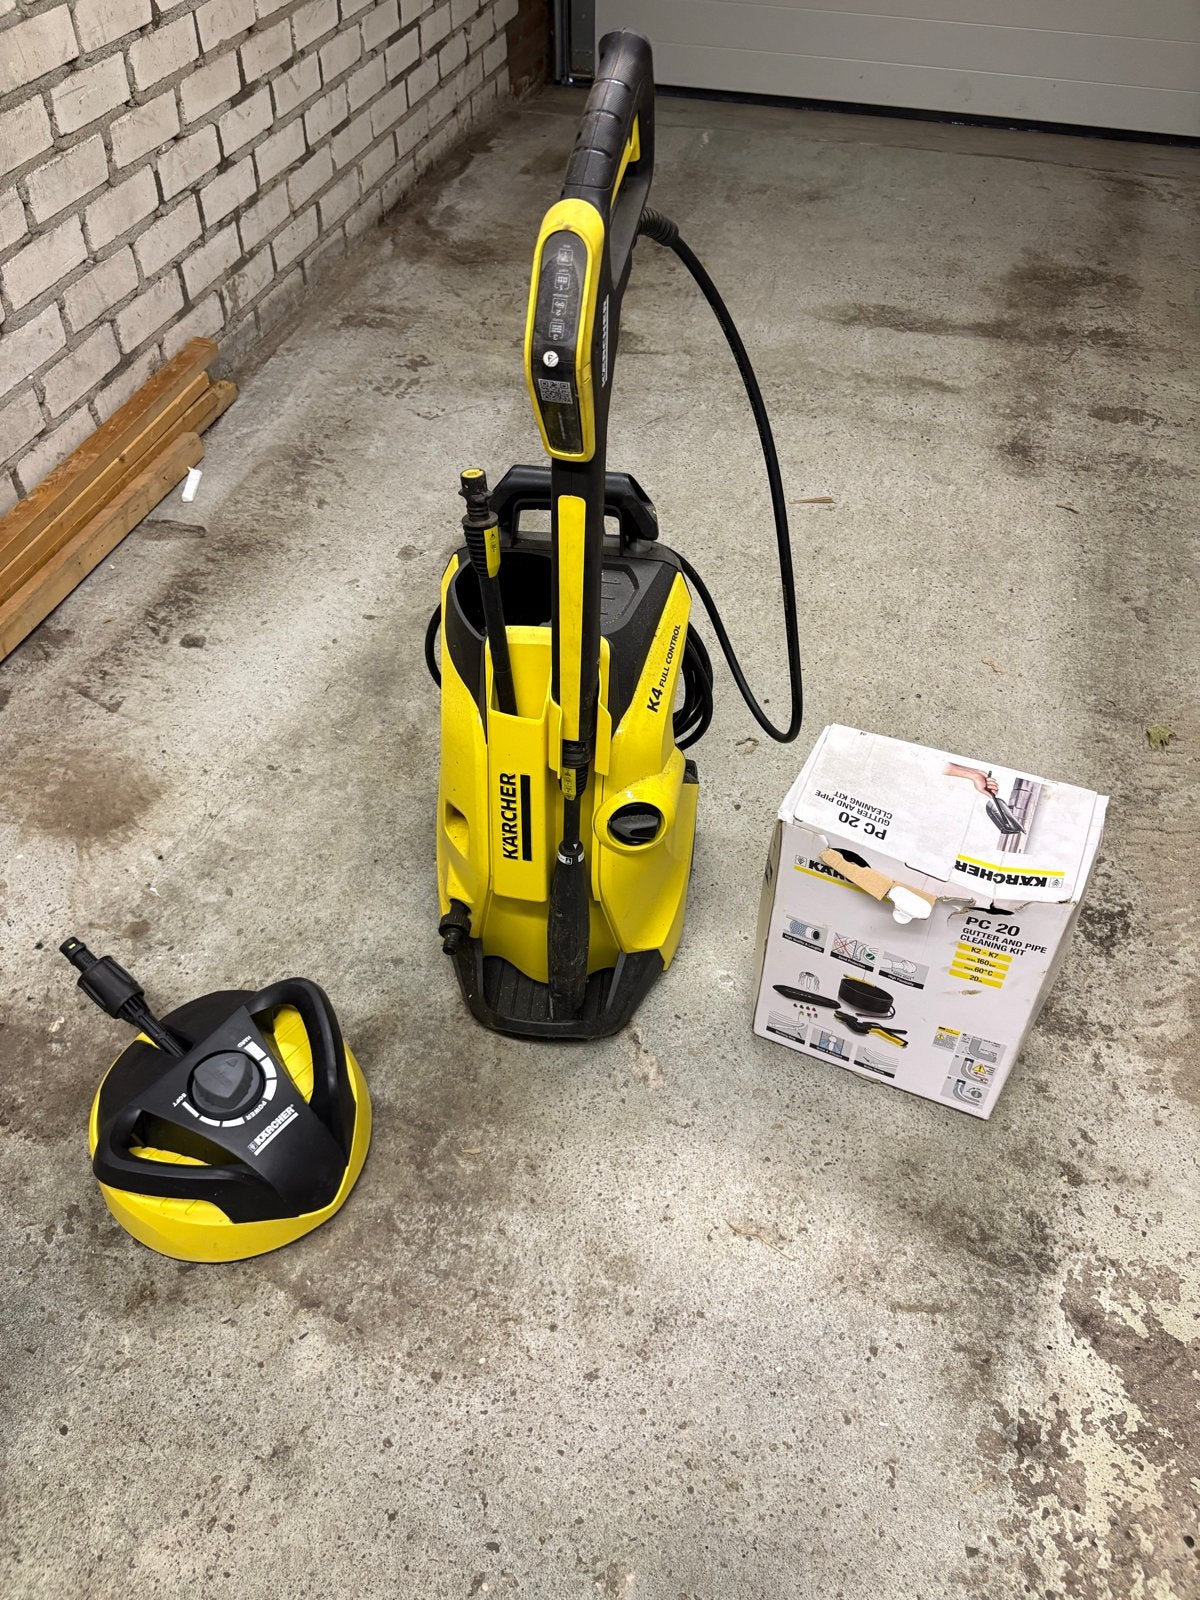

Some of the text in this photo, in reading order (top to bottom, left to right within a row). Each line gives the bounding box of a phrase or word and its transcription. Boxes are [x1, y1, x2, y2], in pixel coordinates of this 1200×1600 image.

[646, 625, 681, 713] K4 FULL CONTROL
[499, 772, 518, 860] KÄRCHER
[814, 789, 890, 826] GUTTER AND PIPE
[833, 791, 893, 820] CLEANING KIT
[838, 811, 887, 840] PC 20
[954, 859, 1047, 887] KÄRCHER
[962, 927, 1048, 954] GUTTER AND PIPE
[965, 916, 1020, 937] PC 20
[960, 934, 1026, 956] CLEANING KIT
[970, 946, 982, 955] K2
[988, 951, 999, 959] K7
[245, 1100, 268, 1121] POWER
